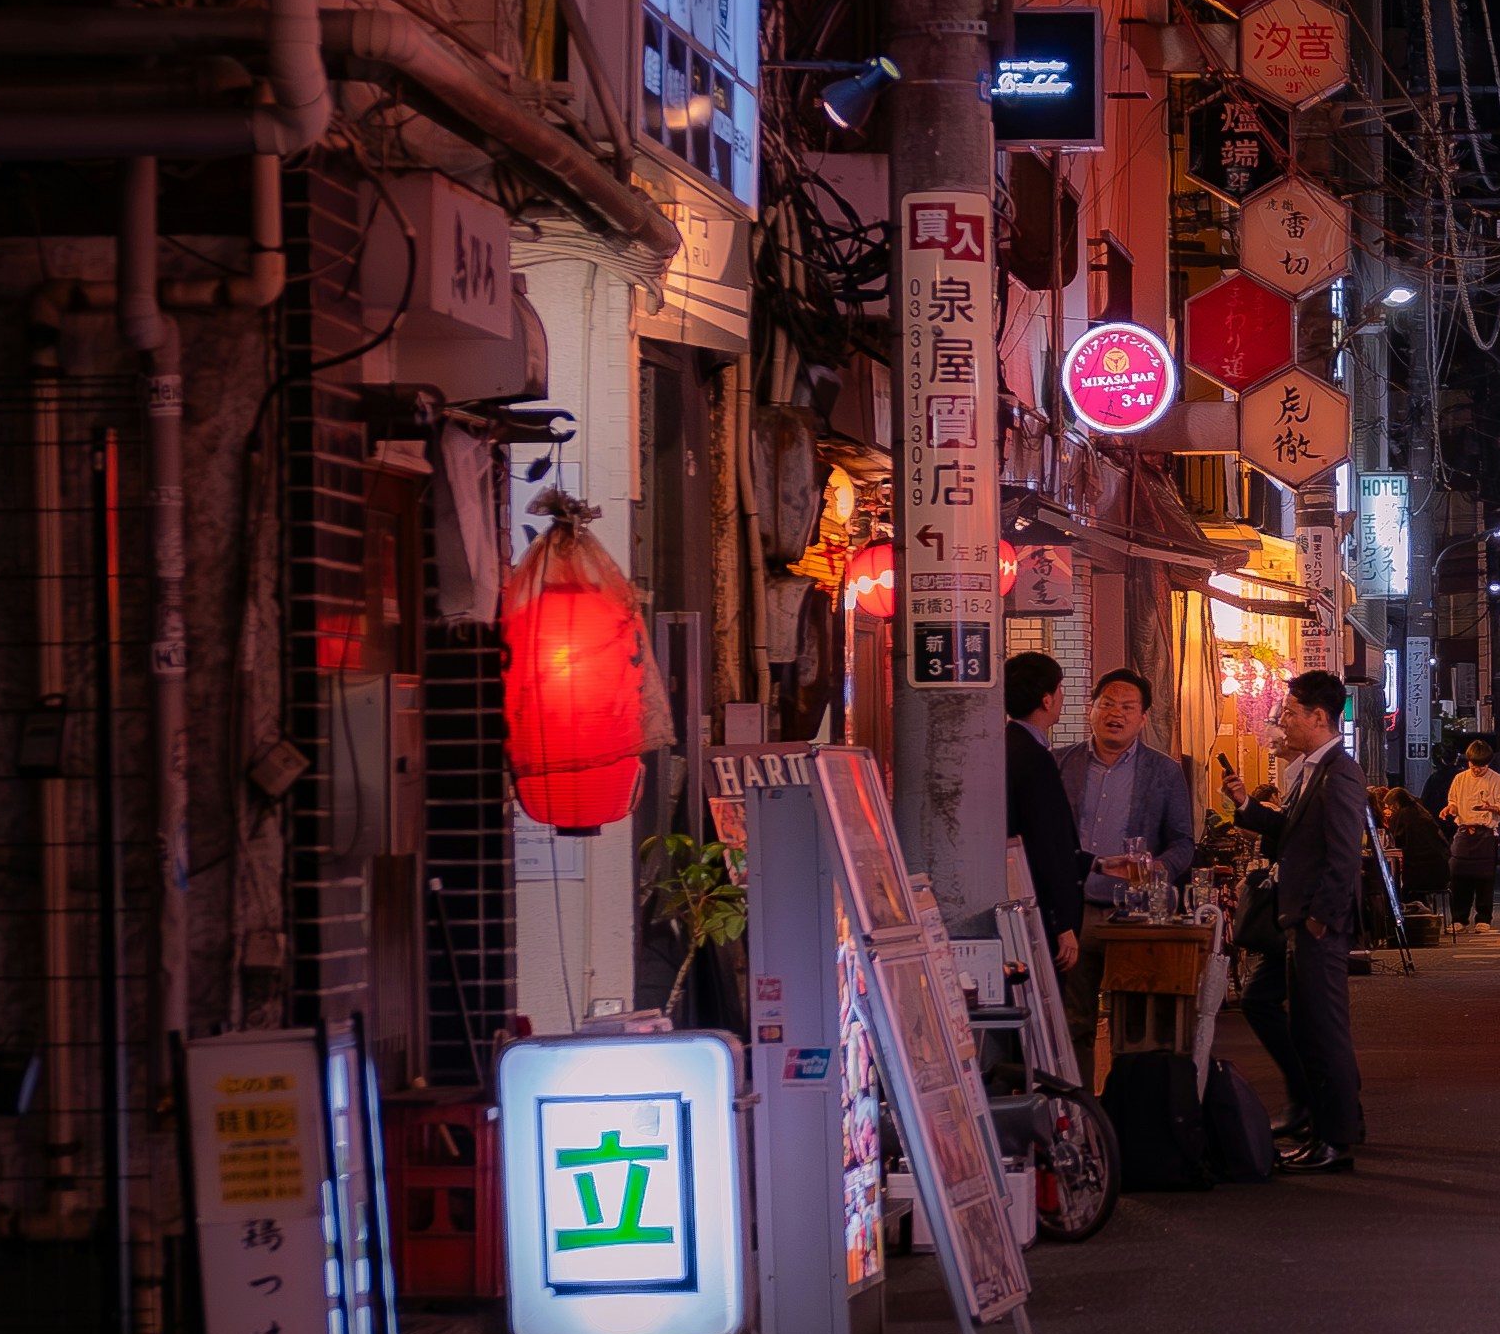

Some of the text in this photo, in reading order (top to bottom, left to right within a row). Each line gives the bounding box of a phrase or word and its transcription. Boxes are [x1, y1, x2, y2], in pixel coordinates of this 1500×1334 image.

[1253, 22, 1334, 60] 汐音
[1286, 81, 1304, 94] 2F
[1229, 173, 1249, 187] 2F
[916, 208, 982, 257] 買入
[1280, 211, 1310, 276] 雷切
[1074, 333, 1161, 373] イタリアンワインバール
[909, 278, 924, 507] 03(3431)3049
[927, 275, 977, 507] 泉屋質店
[1081, 371, 1157, 387] MIKASA BAR
[1272, 384, 1328, 465] 虎徹
[1362, 478, 1408, 497] HOTEL
[951, 543, 989, 564] 左折
[1362, 514, 1377, 580] チェックイン
[911, 597, 993, 615] 新橋3-15-2
[925, 635, 984, 653] 新橋
[929, 657, 981, 678] 3-13
[1412, 651, 1424, 728] アップステージ
[555, 1129, 675, 1252] 立
